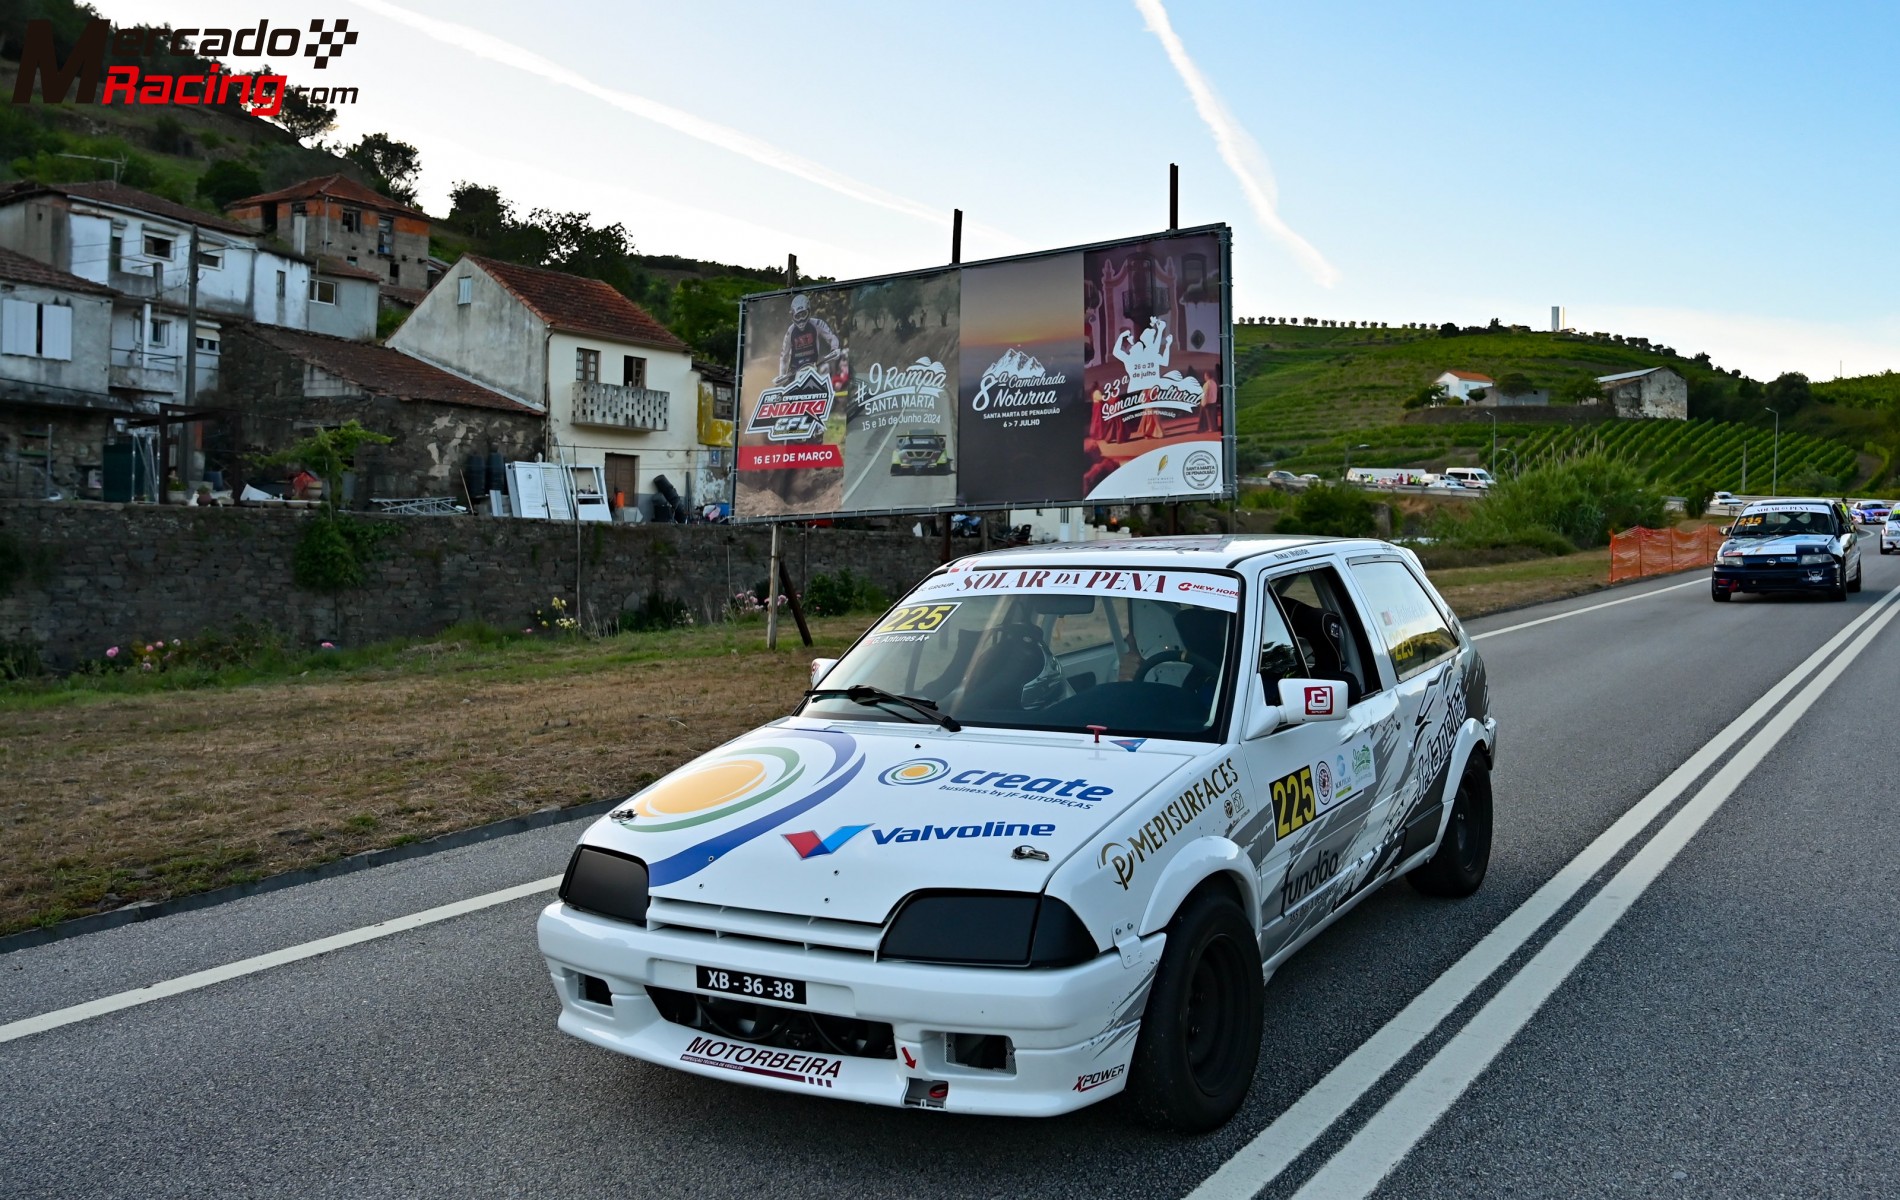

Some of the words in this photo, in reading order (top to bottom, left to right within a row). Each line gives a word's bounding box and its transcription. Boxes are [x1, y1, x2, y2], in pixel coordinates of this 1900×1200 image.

[884, 367, 946, 392] Rampa
[1008, 371, 1066, 388] Caminhada
[1141, 370, 1156, 378] julho
[756, 399, 828, 420] ENDURO
[865, 396, 898, 415] SANTA
[901, 395, 935, 409] MARTA
[993, 388, 1057, 408] Noturna
[1101, 391, 1146, 421] Semana
[1149, 385, 1202, 406] Cultural
[862, 421, 871, 431] 15
[872, 420, 877, 428] e
[879, 417, 887, 427] 16
[888, 416, 898, 424] de
[899, 413, 922, 424] Junho
[923, 413, 941, 424] 2024
[1020, 419, 1040, 427] JULHO
[754, 456, 763, 464] 16
[765, 455, 771, 464] E
[773, 454, 780, 462] 17
[783, 453, 796, 462] DE
[798, 450, 833, 461] MARÇO
[957, 570, 1051, 591] SOLAR
[1085, 571, 1166, 593] PENA
[876, 605, 952, 635] 225
[881, 634, 916, 643] Antunes
[938, 785, 988, 795] business
[1020, 794, 1094, 811] AUTOPEÇAS
[950, 770, 1114, 802] create
[1127, 757, 1239, 863] MEPISURFACES
[1273, 768, 1315, 839] 225
[872, 821, 1056, 845] Valvoline
[1280, 849, 1339, 918] fundão
[685, 1036, 843, 1078] MOTORBEIRA
[1072, 1064, 1125, 1092] XPOWER
